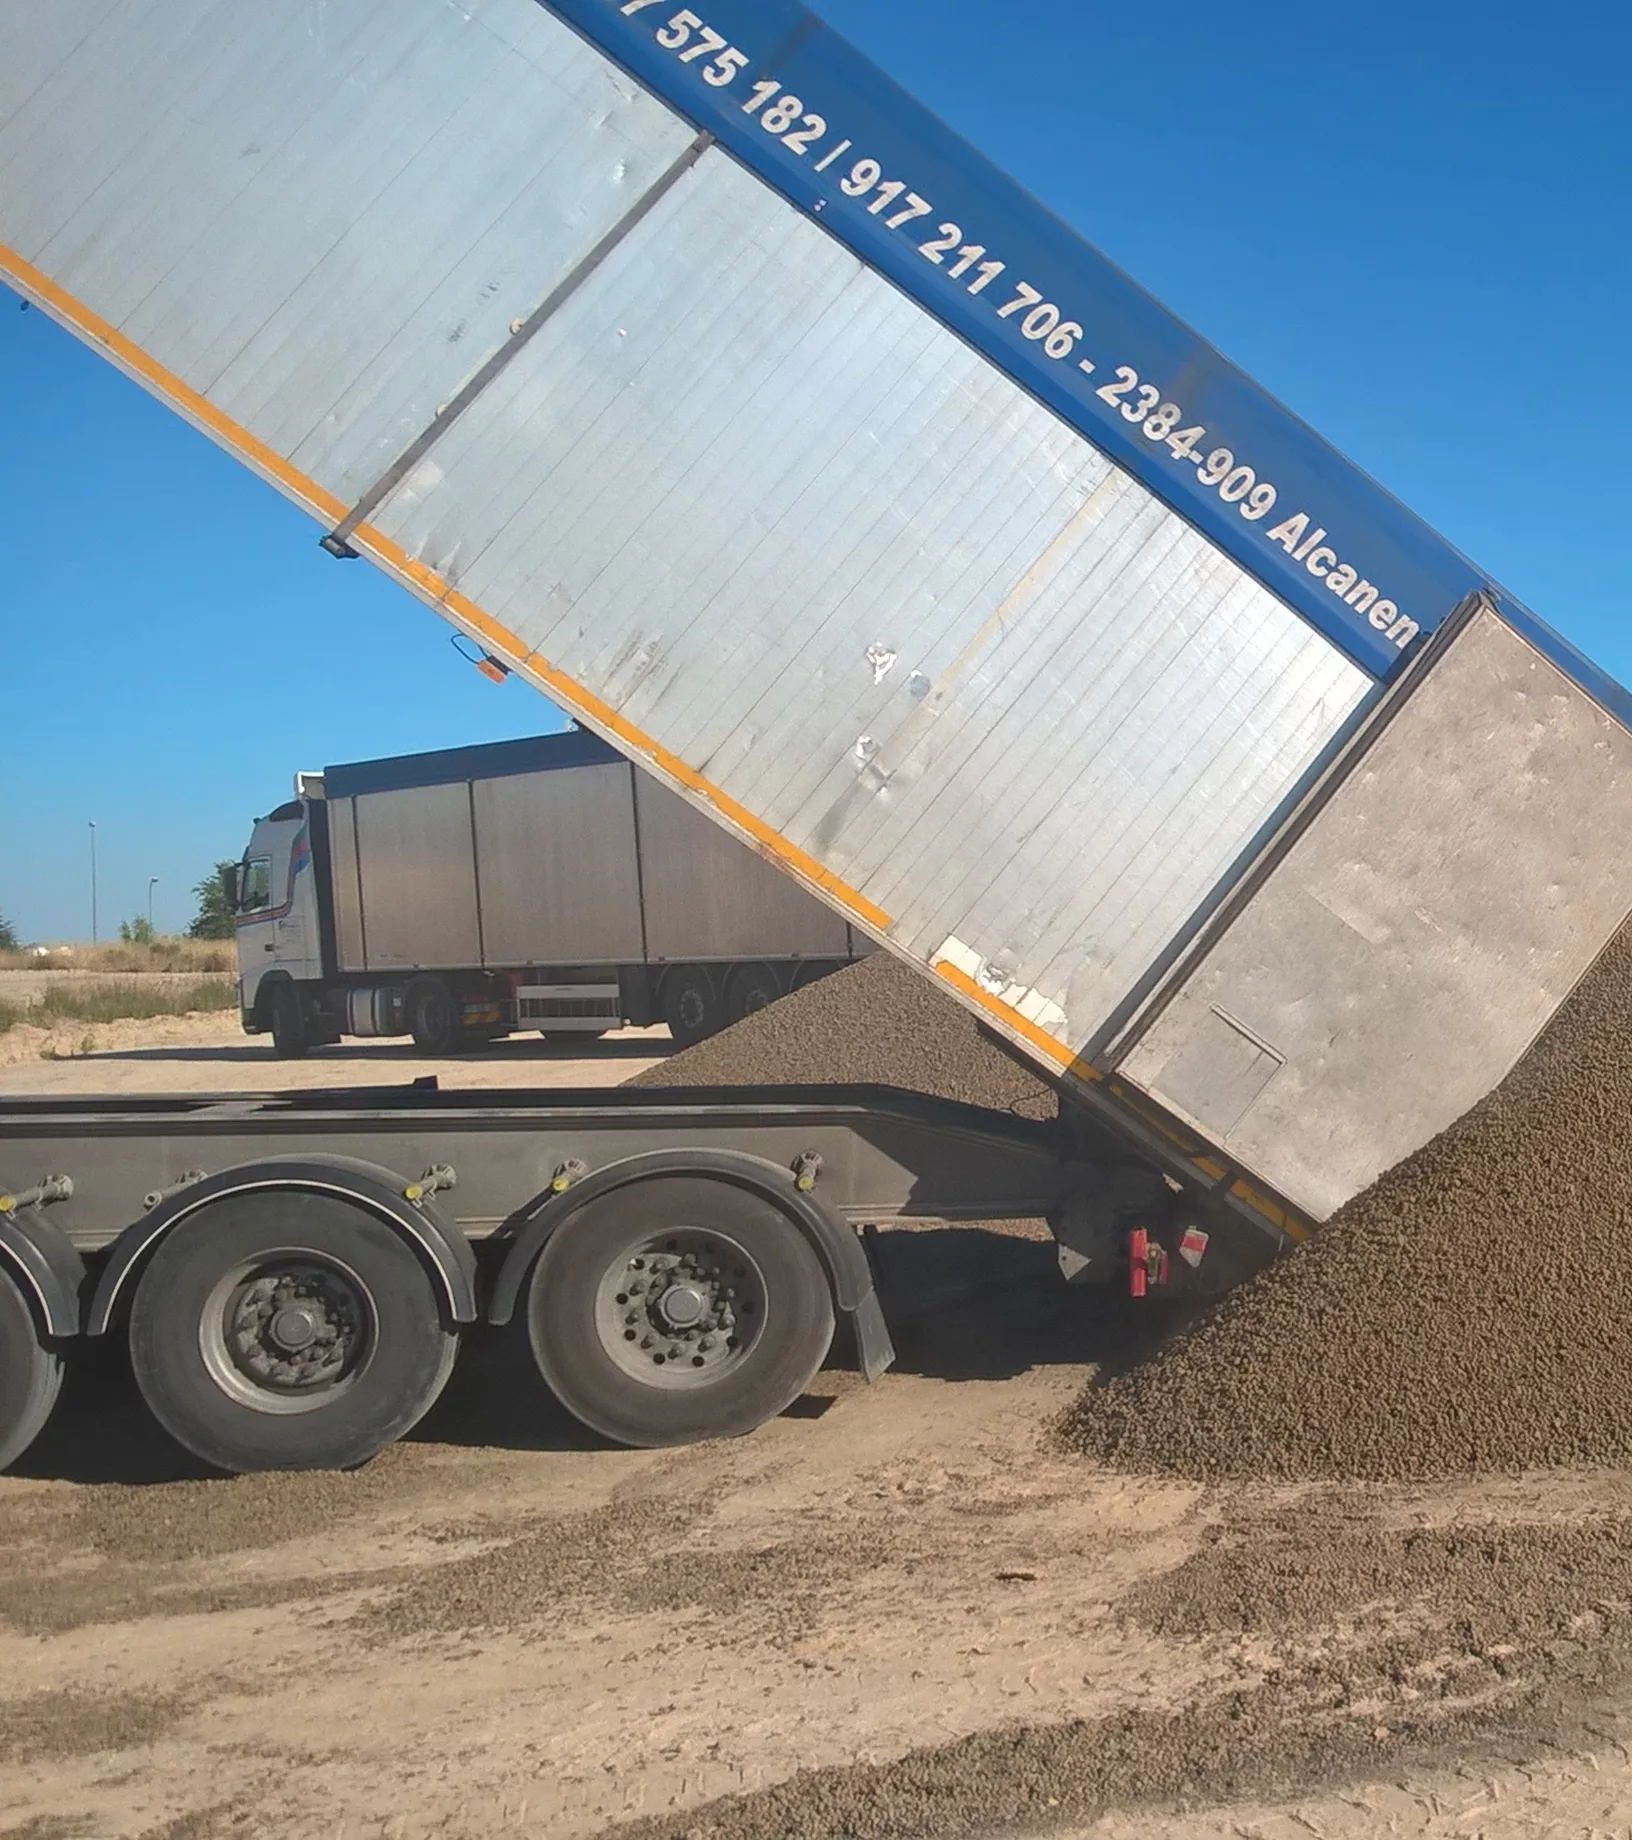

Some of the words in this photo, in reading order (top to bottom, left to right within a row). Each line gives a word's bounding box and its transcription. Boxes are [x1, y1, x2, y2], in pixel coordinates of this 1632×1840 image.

[655, 8, 750, 87] 575
[740, 80, 827, 157] 182
[839, 158, 933, 230] 917
[917, 222, 1006, 296] 211
[996, 281, 1084, 360] 706
[1095, 365, 1278, 521] 2384-909
[1265, 511, 1420, 649] Alcanen
